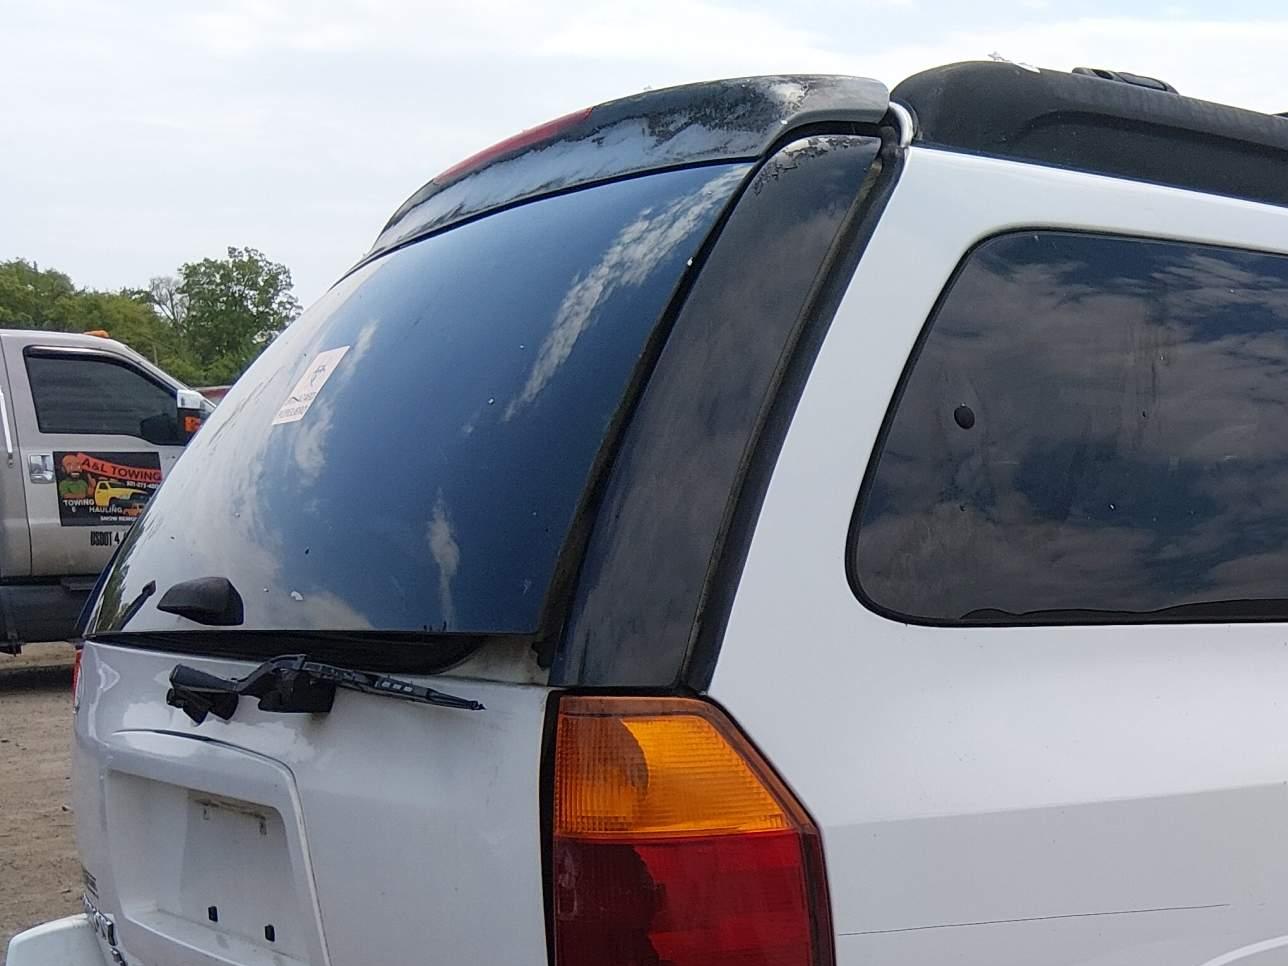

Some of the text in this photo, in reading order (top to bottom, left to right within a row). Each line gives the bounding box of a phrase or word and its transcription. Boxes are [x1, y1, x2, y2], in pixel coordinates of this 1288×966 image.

[81, 458, 162, 481] A&L TOWING
[63, 498, 95, 507] TOWING
[88, 504, 123, 513] HAULING
[90, 531, 113, 546] USDOT
